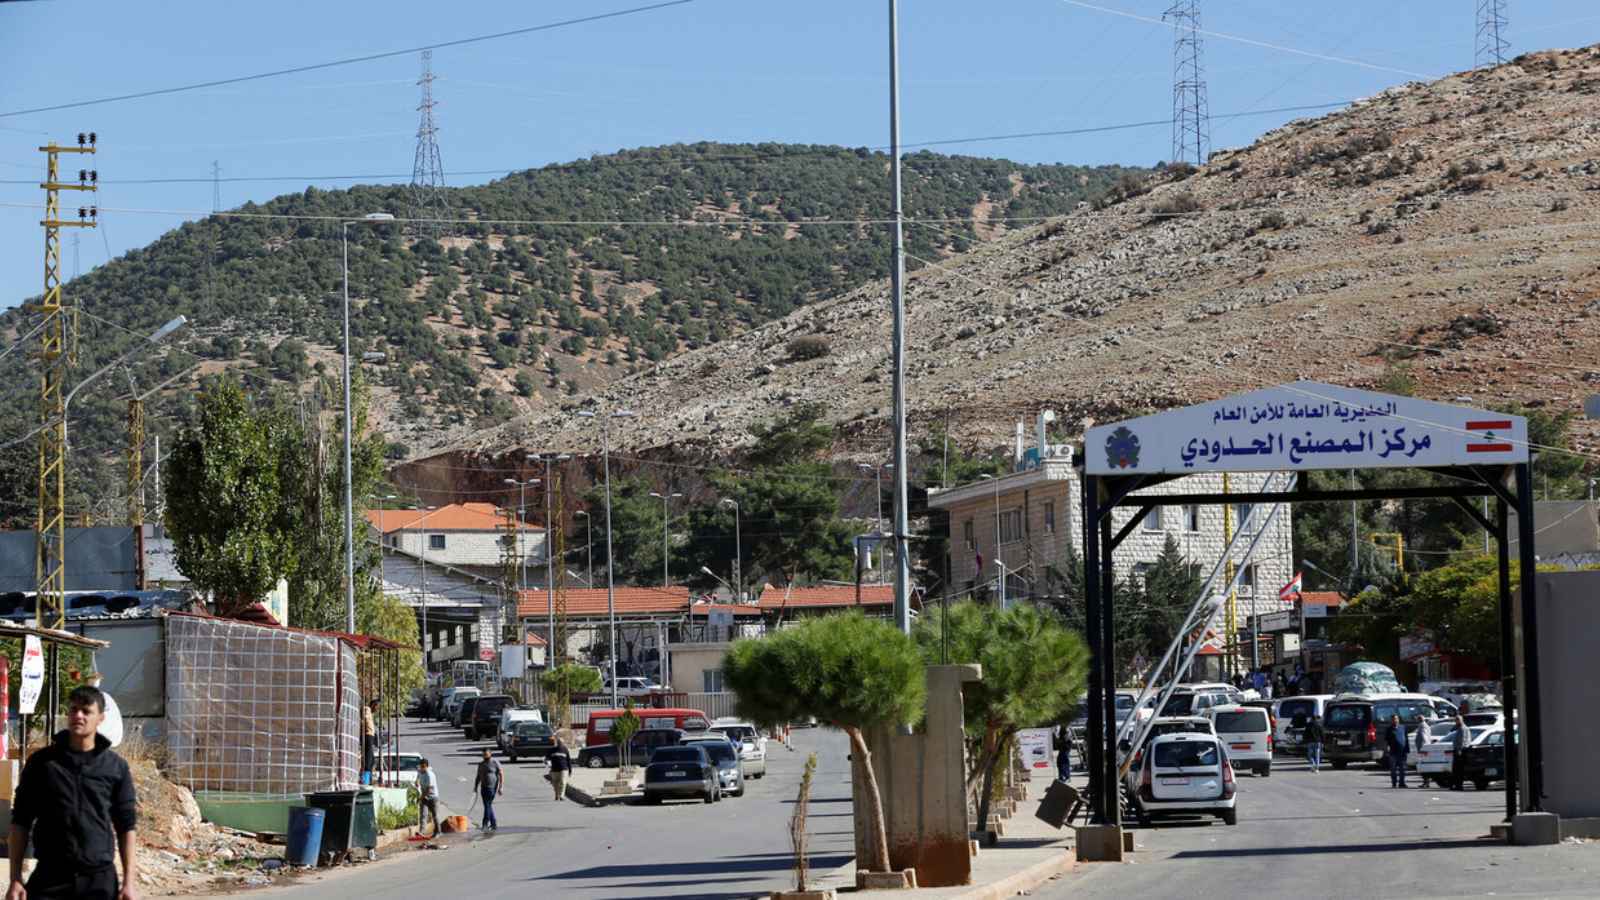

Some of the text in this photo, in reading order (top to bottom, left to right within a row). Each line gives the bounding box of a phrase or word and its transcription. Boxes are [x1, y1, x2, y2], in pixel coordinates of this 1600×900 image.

[1213, 406, 1247, 425] العام
[1250, 402, 1284, 424] للأمن
[1287, 402, 1330, 418] العامة
[1181, 427, 1431, 467] مركز المصنع الحدودي
